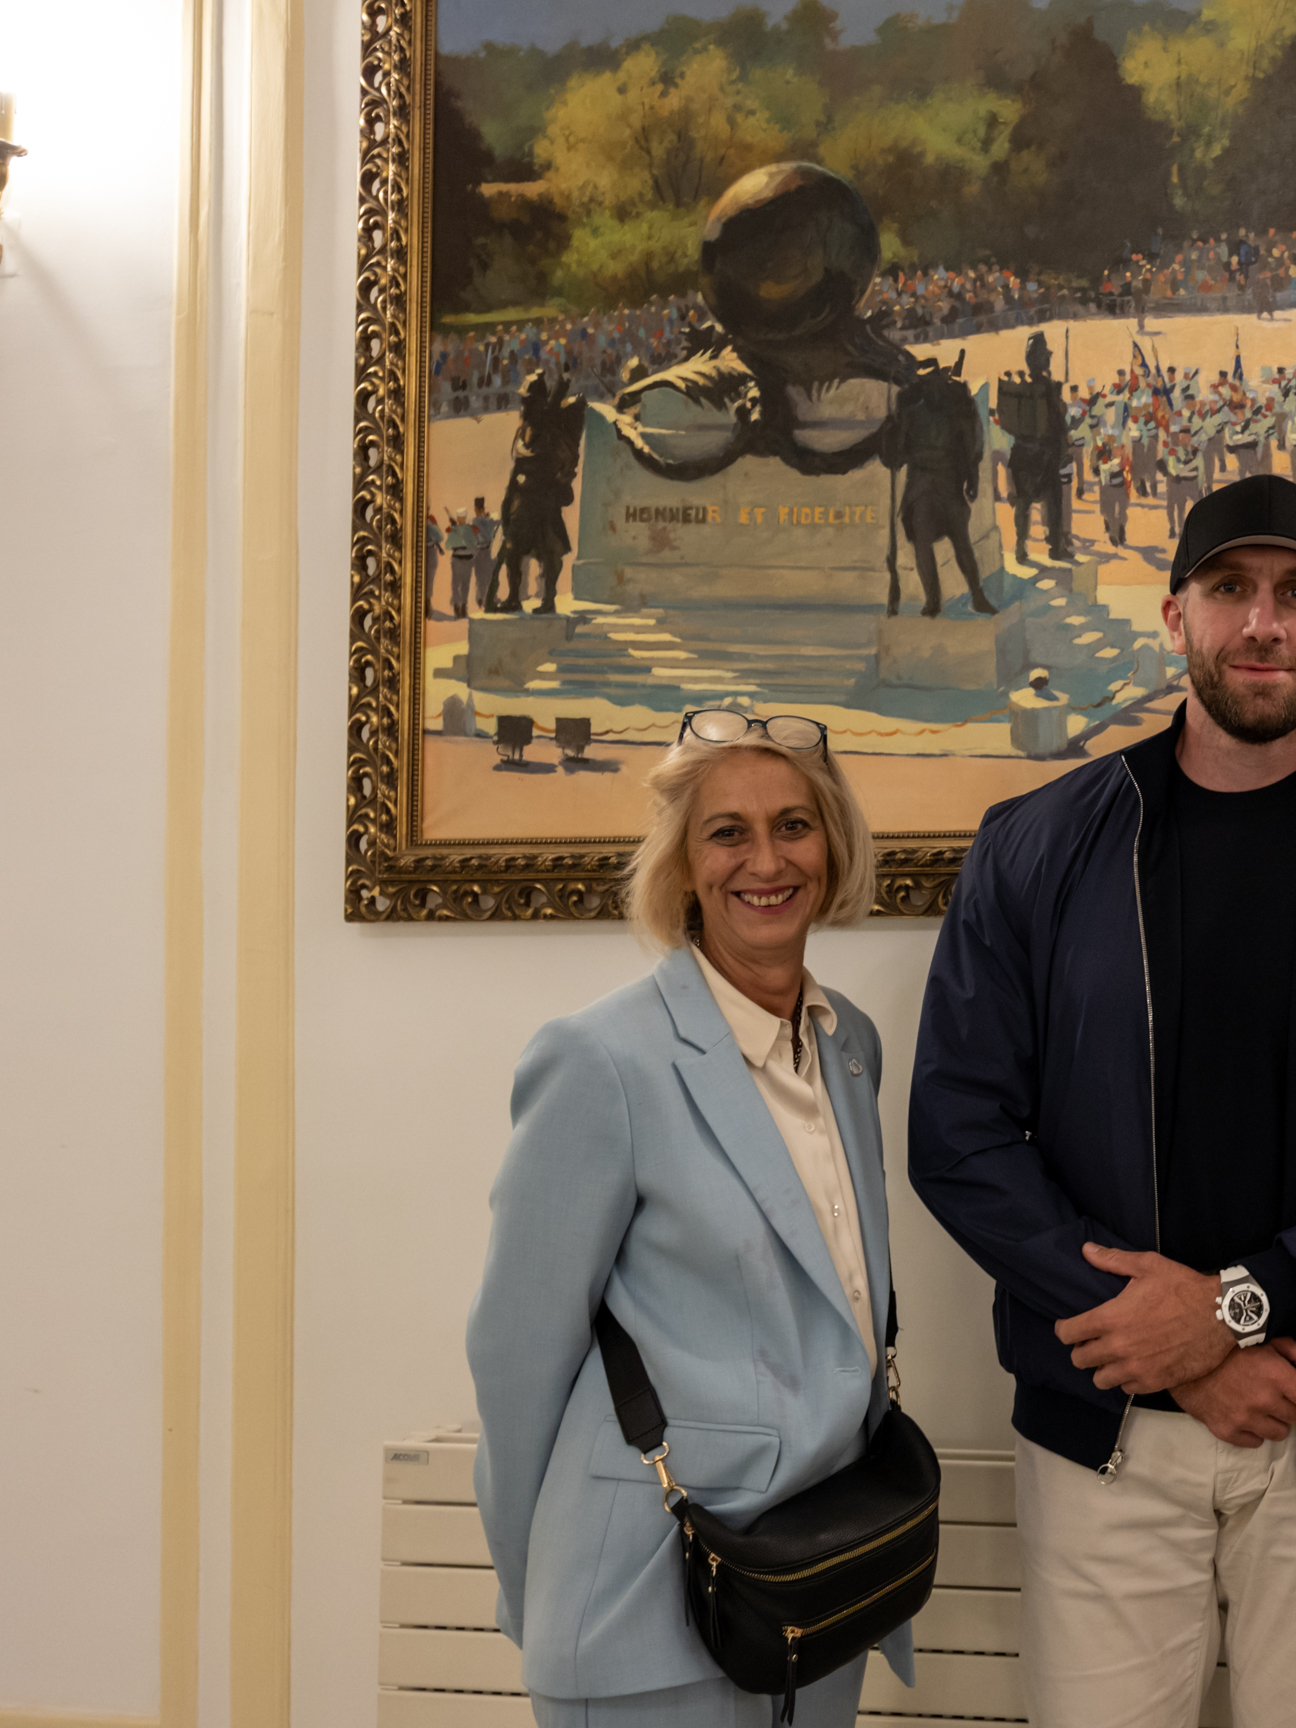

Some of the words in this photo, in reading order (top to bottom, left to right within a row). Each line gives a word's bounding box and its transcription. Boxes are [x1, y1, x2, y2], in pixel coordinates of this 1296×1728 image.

[625, 505, 721, 524] HONNEUR
[740, 507, 766, 524] ET
[779, 505, 877, 524] FIDELITE
